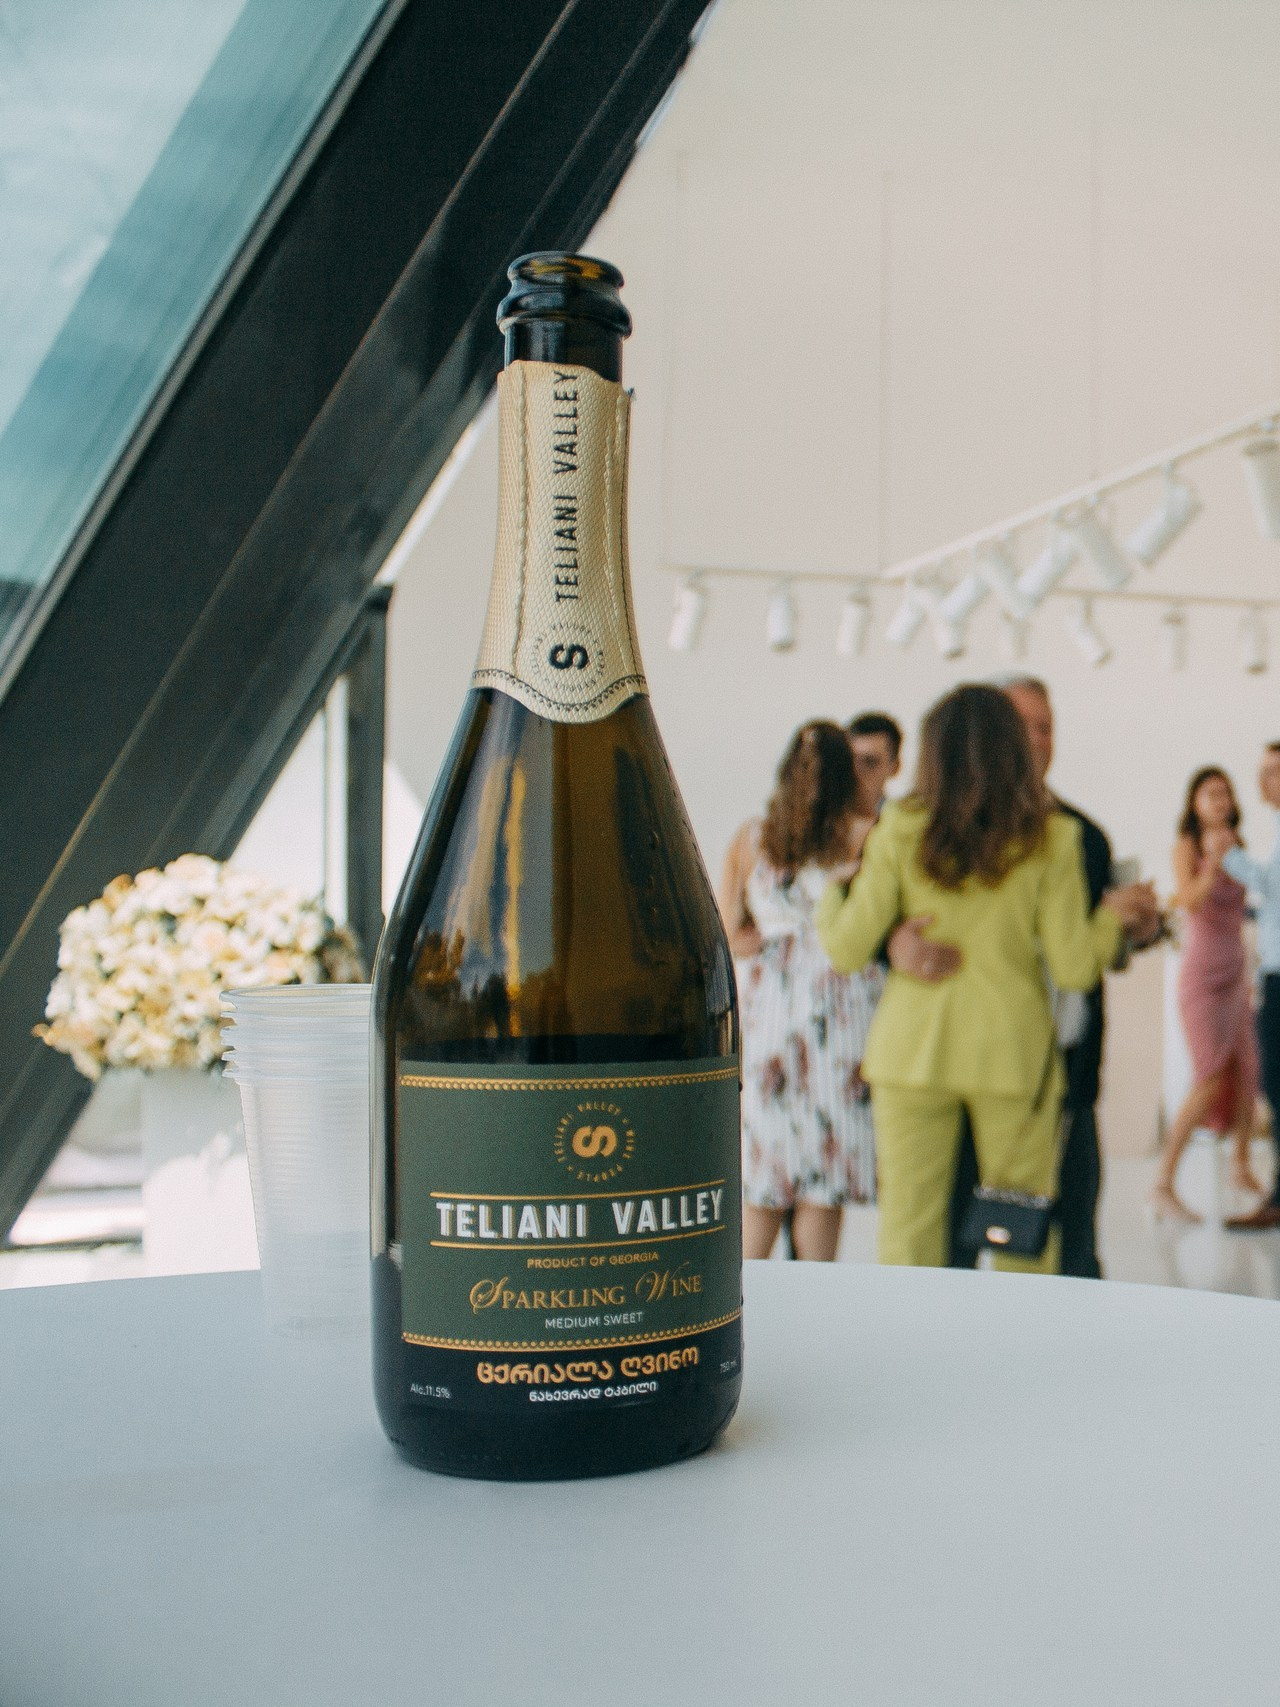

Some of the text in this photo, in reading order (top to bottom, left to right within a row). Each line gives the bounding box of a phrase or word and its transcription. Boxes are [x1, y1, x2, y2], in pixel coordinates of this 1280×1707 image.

[553, 370, 578, 602] TELIANI VALLEY
[577, 1101, 621, 1116] VALLEY
[436, 1188, 723, 1239] TELIANI VALLEY
[526, 1251, 660, 1269] PRODUCT OF GEORGIA
[544, 1311, 644, 1329] MEDIUM SWEET
[476, 1346, 699, 1385] ცქრიალა ღვინო
[529, 1381, 657, 1402] ნახევრად ტკბილი
